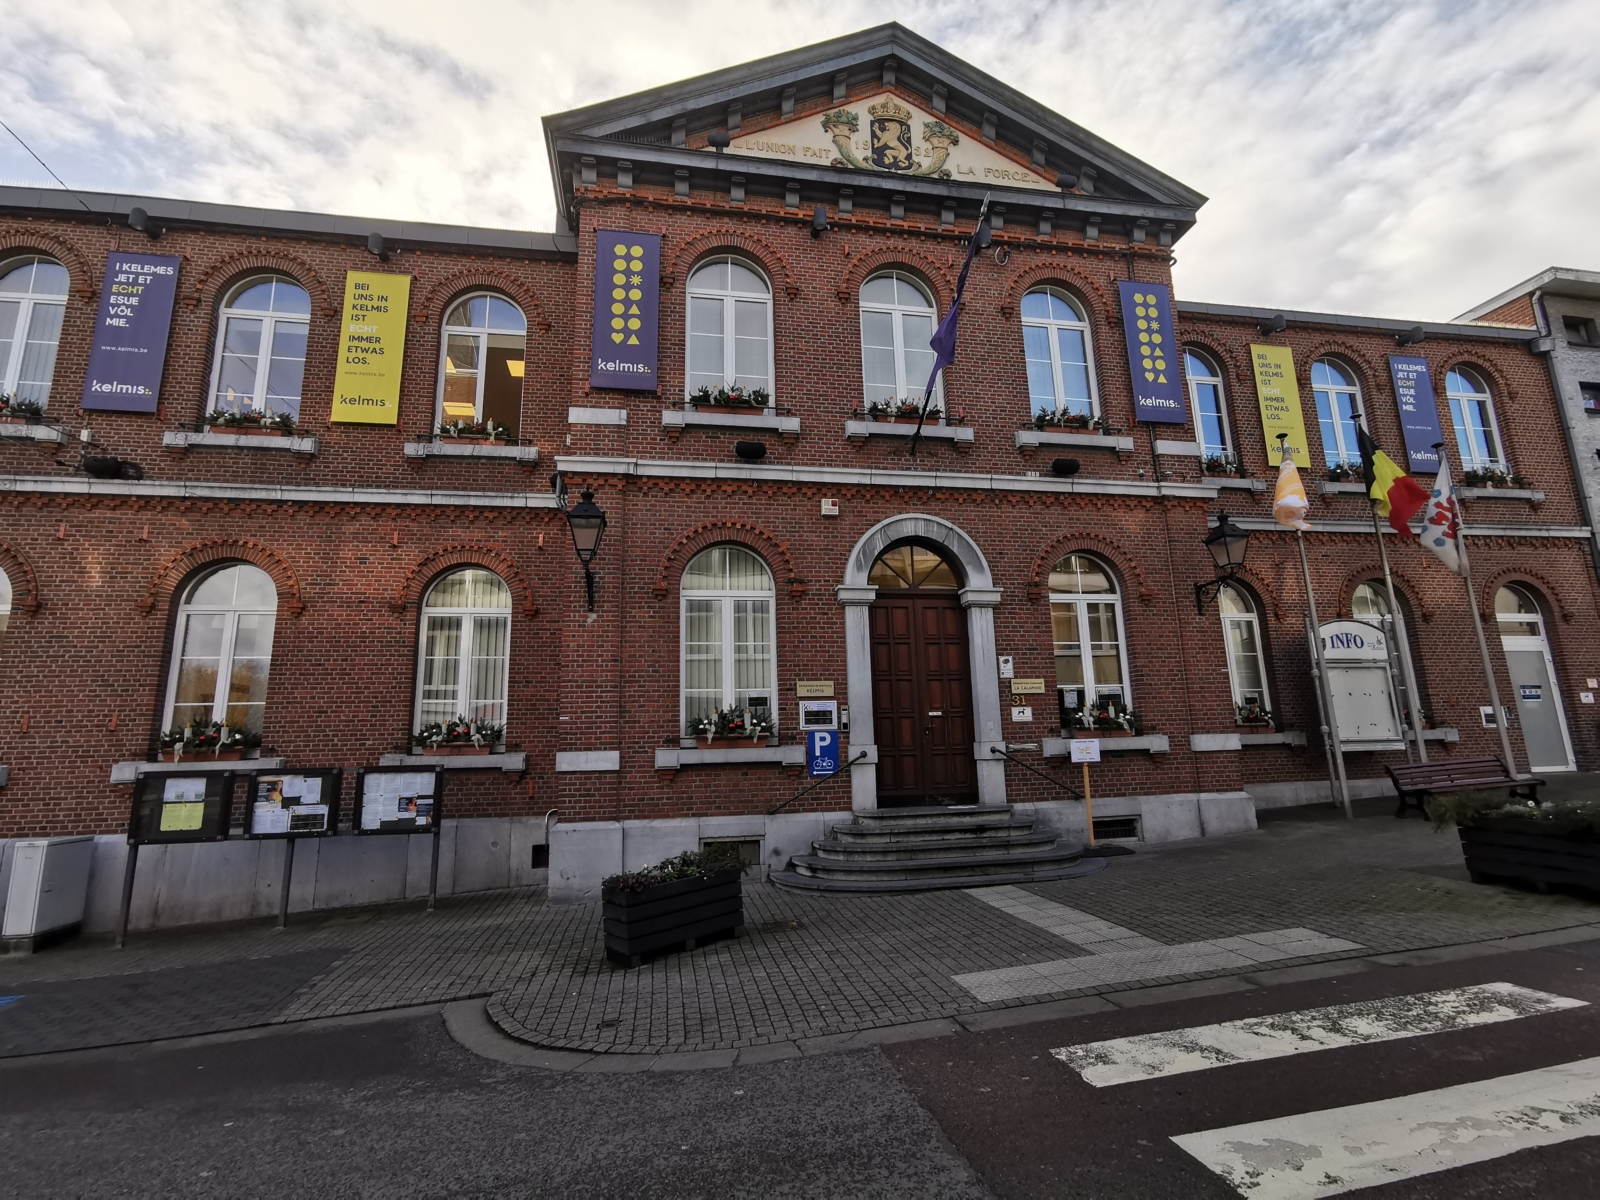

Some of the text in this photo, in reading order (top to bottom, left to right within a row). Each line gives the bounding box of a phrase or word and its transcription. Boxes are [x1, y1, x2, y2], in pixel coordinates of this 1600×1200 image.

[803, 146, 831, 159] FAIT
[957, 164, 1031, 183] LA FORCE
[115, 262, 174, 275] I KELEMES
[114, 274, 153, 284] JET ET
[111, 284, 144, 294] ECHT
[354, 282, 370, 291] BEI
[109, 295, 139, 305] ESUE
[353, 293, 388, 302] UNS IN
[108, 305, 134, 316] VÖL
[352, 303, 389, 313] KELMIS
[105, 317, 130, 327] MIE.
[350, 313, 367, 322] IST
[349, 324, 378, 333] ECHT
[348, 335, 381, 344] IMMER
[347, 345, 385, 355] ETWAS
[346, 356, 370, 365] LOS.
[1257, 353, 1268, 361] BEI
[1398, 363, 1426, 372] KELEMES
[1263, 396, 1285, 404] IMMER
[1401, 395, 1416, 403] VÖL
[1266, 413, 1283, 421] LOS.
[1329, 632, 1364, 649] INFO
[1012, 695, 1026, 706] 31
[814, 731, 831, 757] P
